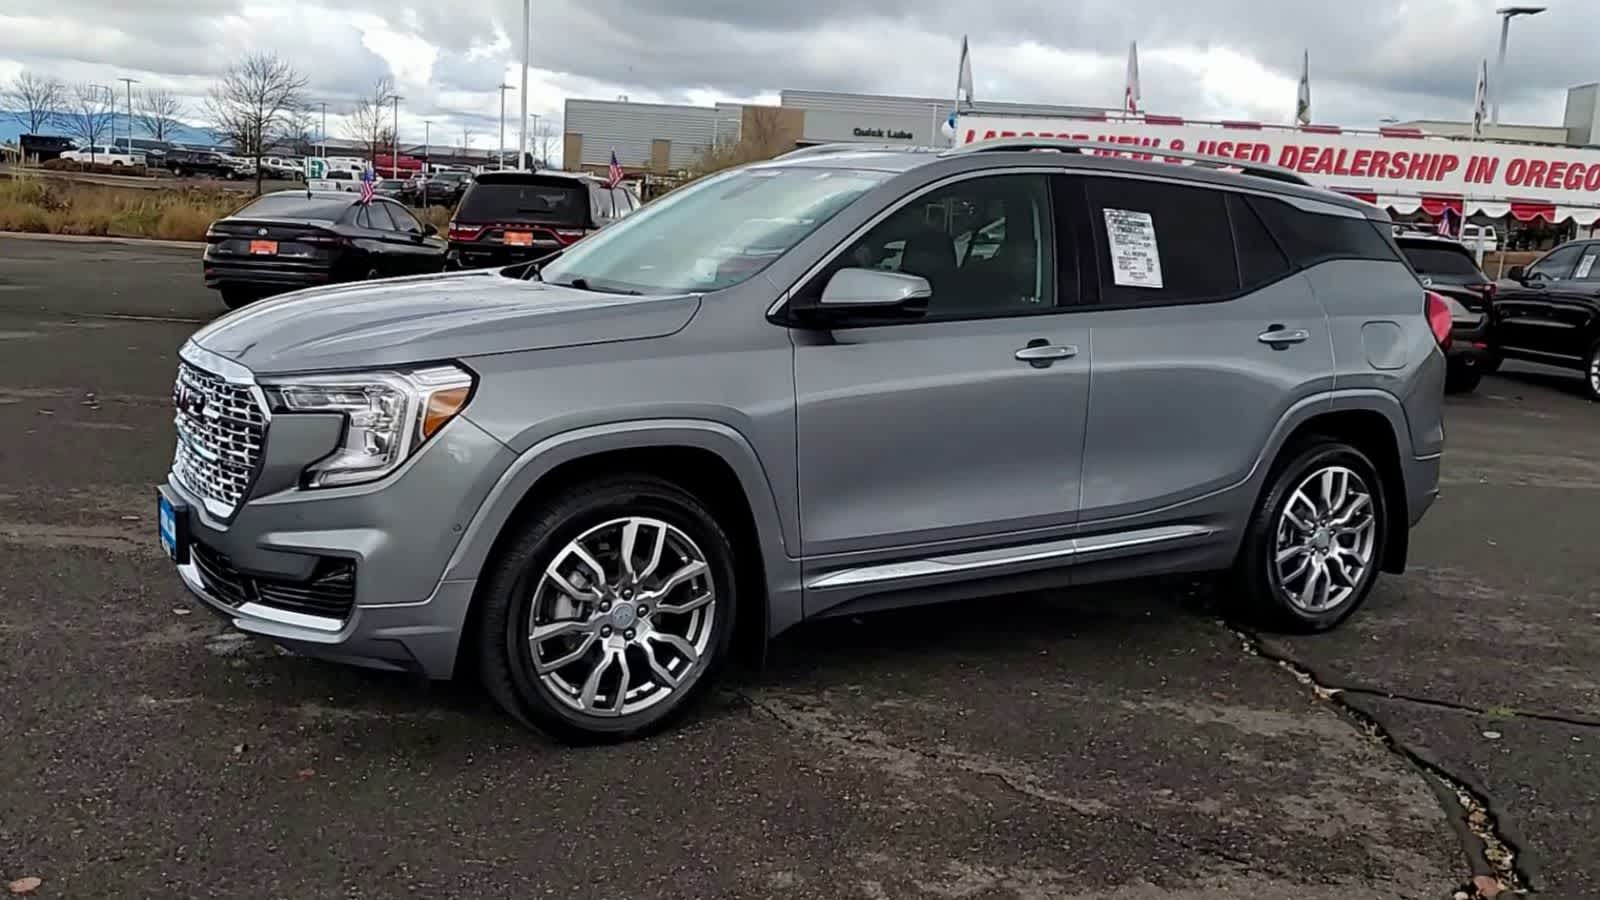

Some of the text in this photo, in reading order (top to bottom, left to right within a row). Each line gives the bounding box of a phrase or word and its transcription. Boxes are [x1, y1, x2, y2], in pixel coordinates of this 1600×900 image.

[853, 127, 913, 140] Quick Lube
[1277, 145, 1460, 181] DEALERSHIP
[1464, 155, 1500, 184] IN
